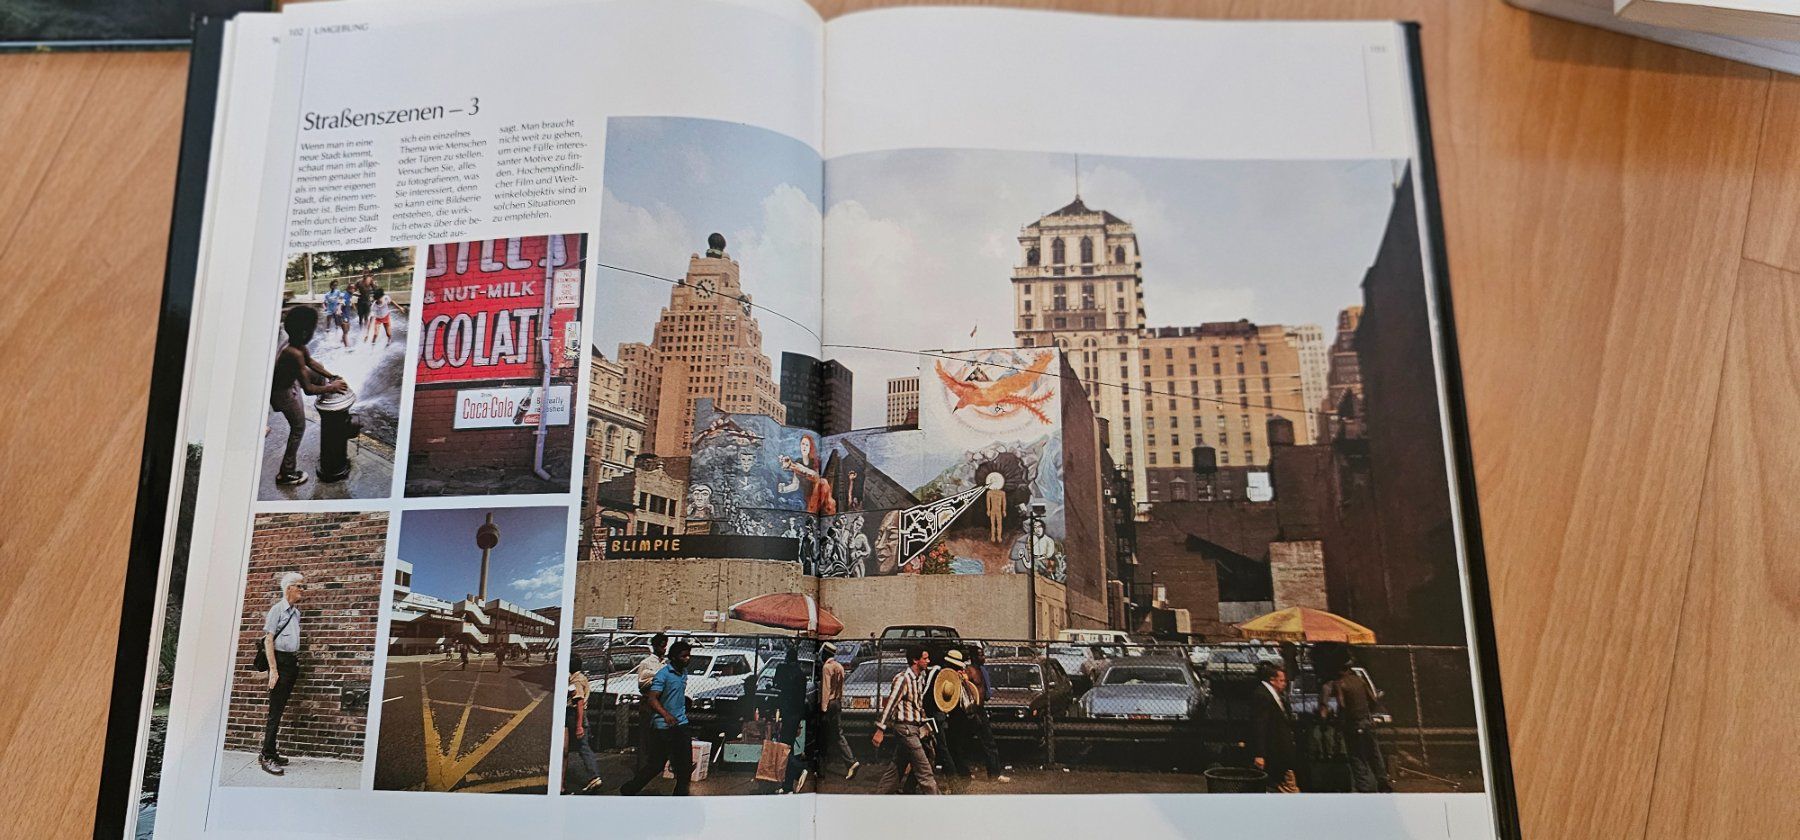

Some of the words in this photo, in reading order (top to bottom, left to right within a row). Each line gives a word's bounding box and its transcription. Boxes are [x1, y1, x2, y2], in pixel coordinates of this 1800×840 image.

[314, 23, 369, 35] UMGEBUNG
[303, 105, 444, 131] Straßenszenen
[468, 97, 480, 116] 3
[542, 119, 574, 129] braucht
[401, 134, 417, 143] sich
[433, 130, 470, 140] einzelnes
[499, 135, 519, 144] nicht
[522, 133, 539, 141] weit
[400, 146, 426, 154] Thema
[446, 139, 487, 149] Menschen
[534, 143, 554, 152] Fülle
[557, 141, 587, 149] interes-
[321, 152, 340, 160] Stadt
[420, 155, 441, 163] Türen
[497, 158, 522, 166] santer
[524, 155, 553, 163] Motive
[299, 164, 324, 172] schaut
[358, 161, 380, 170] allge-
[398, 166, 439, 175] Versuchen
[459, 162, 476, 170] alles
[517, 163, 584, 175] Hochempfindli-
[297, 174, 326, 182] meinen
[329, 173, 361, 181] genauer
[495, 179, 513, 188] cher
[516, 178, 533, 187] Film
[536, 176, 552, 184] und
[555, 175, 579, 183] Weit-
[319, 184, 342, 192] seiner
[344, 182, 376, 191] eigenen
[396, 190, 407, 198] Sie
[457, 184, 477, 192] denn
[495, 188, 555, 199] winkelobjektiv
[558, 186, 576, 194] sind
[319, 195, 332, 203] die
[446, 195, 481, 204] Bildserie
[494, 201, 525, 210] solchen
[528, 198, 575, 208] Situationen
[293, 207, 318, 215] trauter
[335, 205, 355, 213] Beim
[393, 210, 433, 220] entstehen,
[436, 208, 449, 216] die
[452, 206, 472, 214] wirk-
[292, 217, 311, 226] meln
[314, 216, 337, 225] durch
[359, 214, 378, 222] Stadt
[392, 222, 407, 230] lich
[290, 229, 312, 237] sollte
[335, 226, 356, 234] lieber
[359, 225, 377, 233] alles
[391, 232, 426, 241] treffende
[429, 231, 447, 239] Stadt
[346, 237, 372, 245] anstatt
[443, 281, 537, 302] NUT-MILK
[463, 396, 513, 419] Coca-Cola
[612, 539, 680, 552] BLIMPIE
